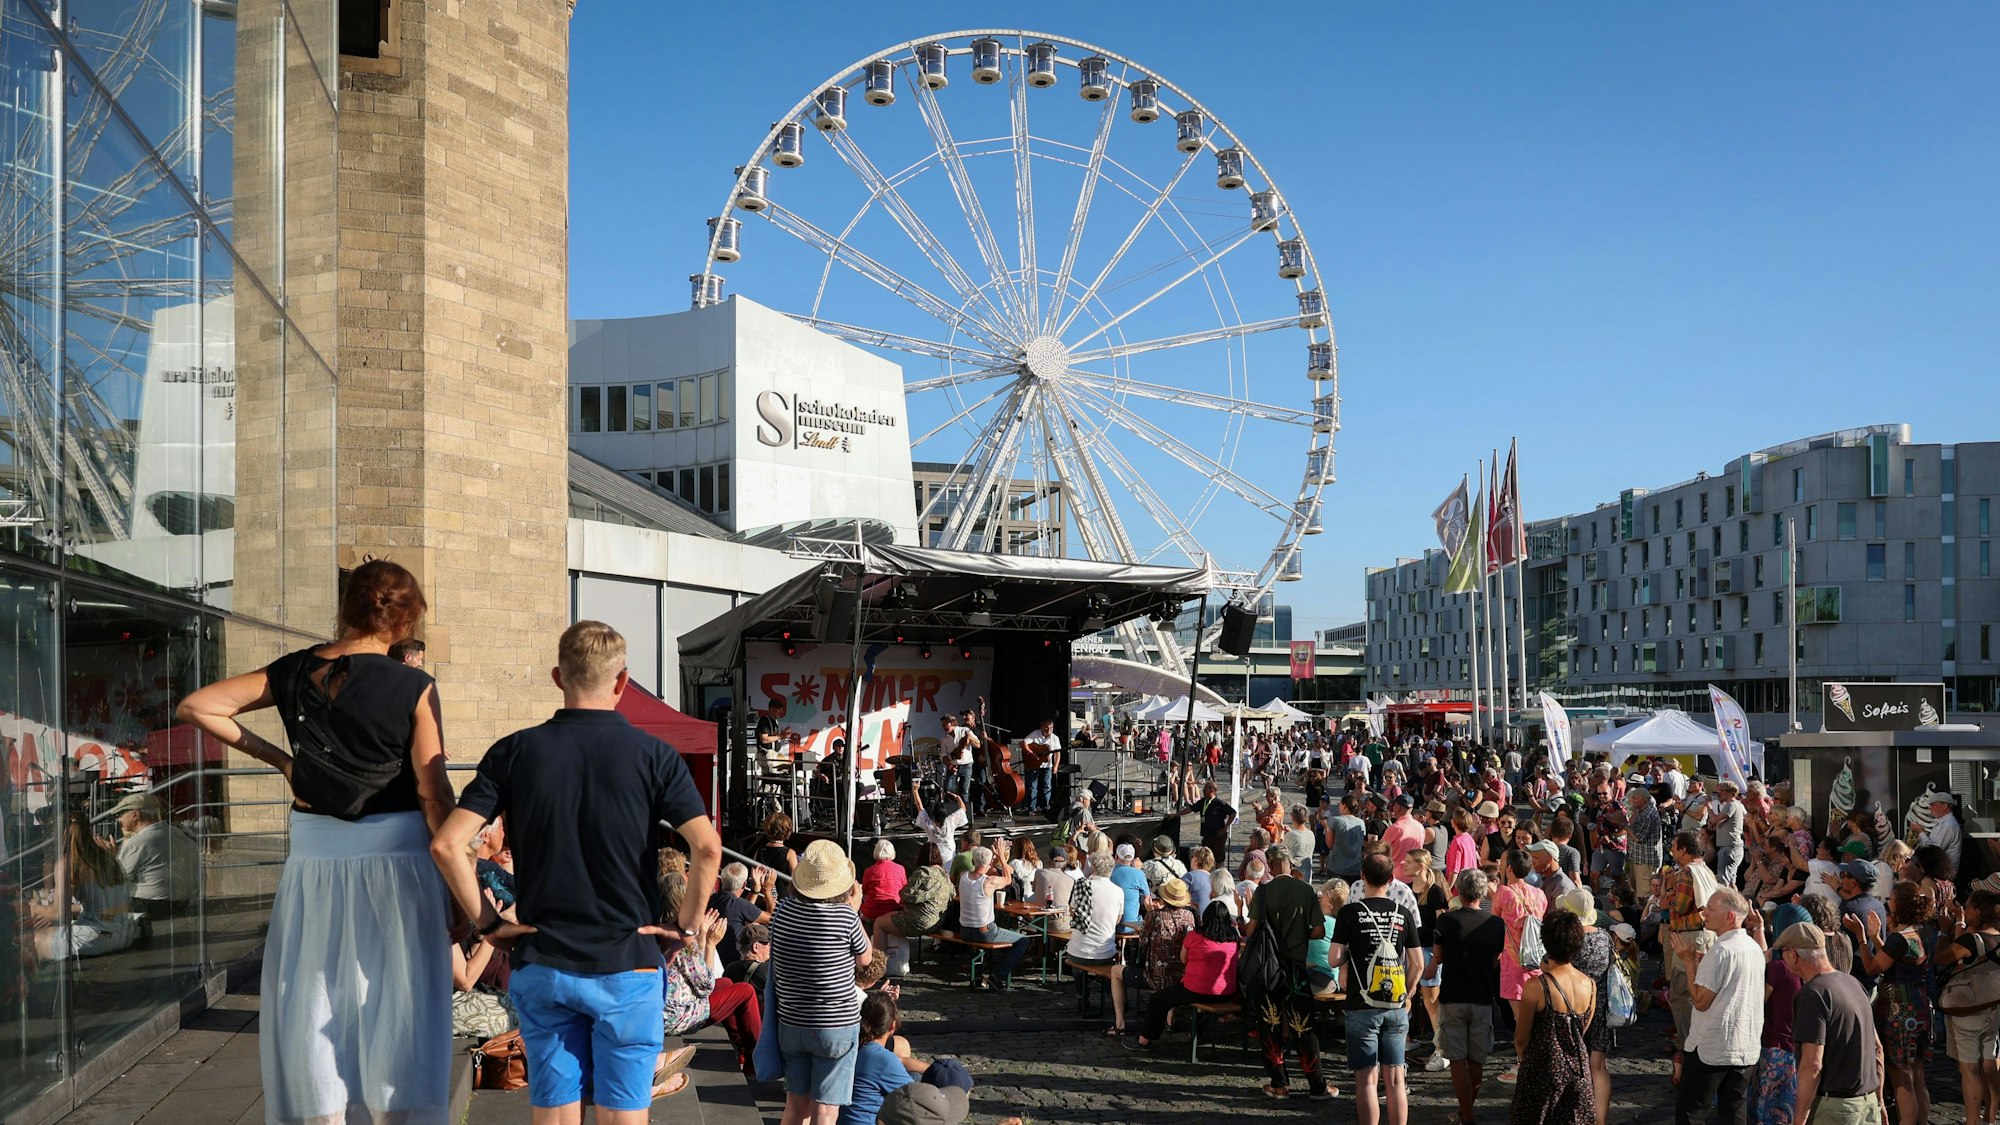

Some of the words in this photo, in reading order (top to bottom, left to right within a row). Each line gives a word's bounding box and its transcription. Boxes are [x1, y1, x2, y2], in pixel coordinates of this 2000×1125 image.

[756, 390, 793, 447] S
[799, 400, 897, 427] schokoladen
[799, 415, 866, 435] museum
[799, 431, 840, 450] Lindt
[1862, 701, 1909, 719] Softeis
